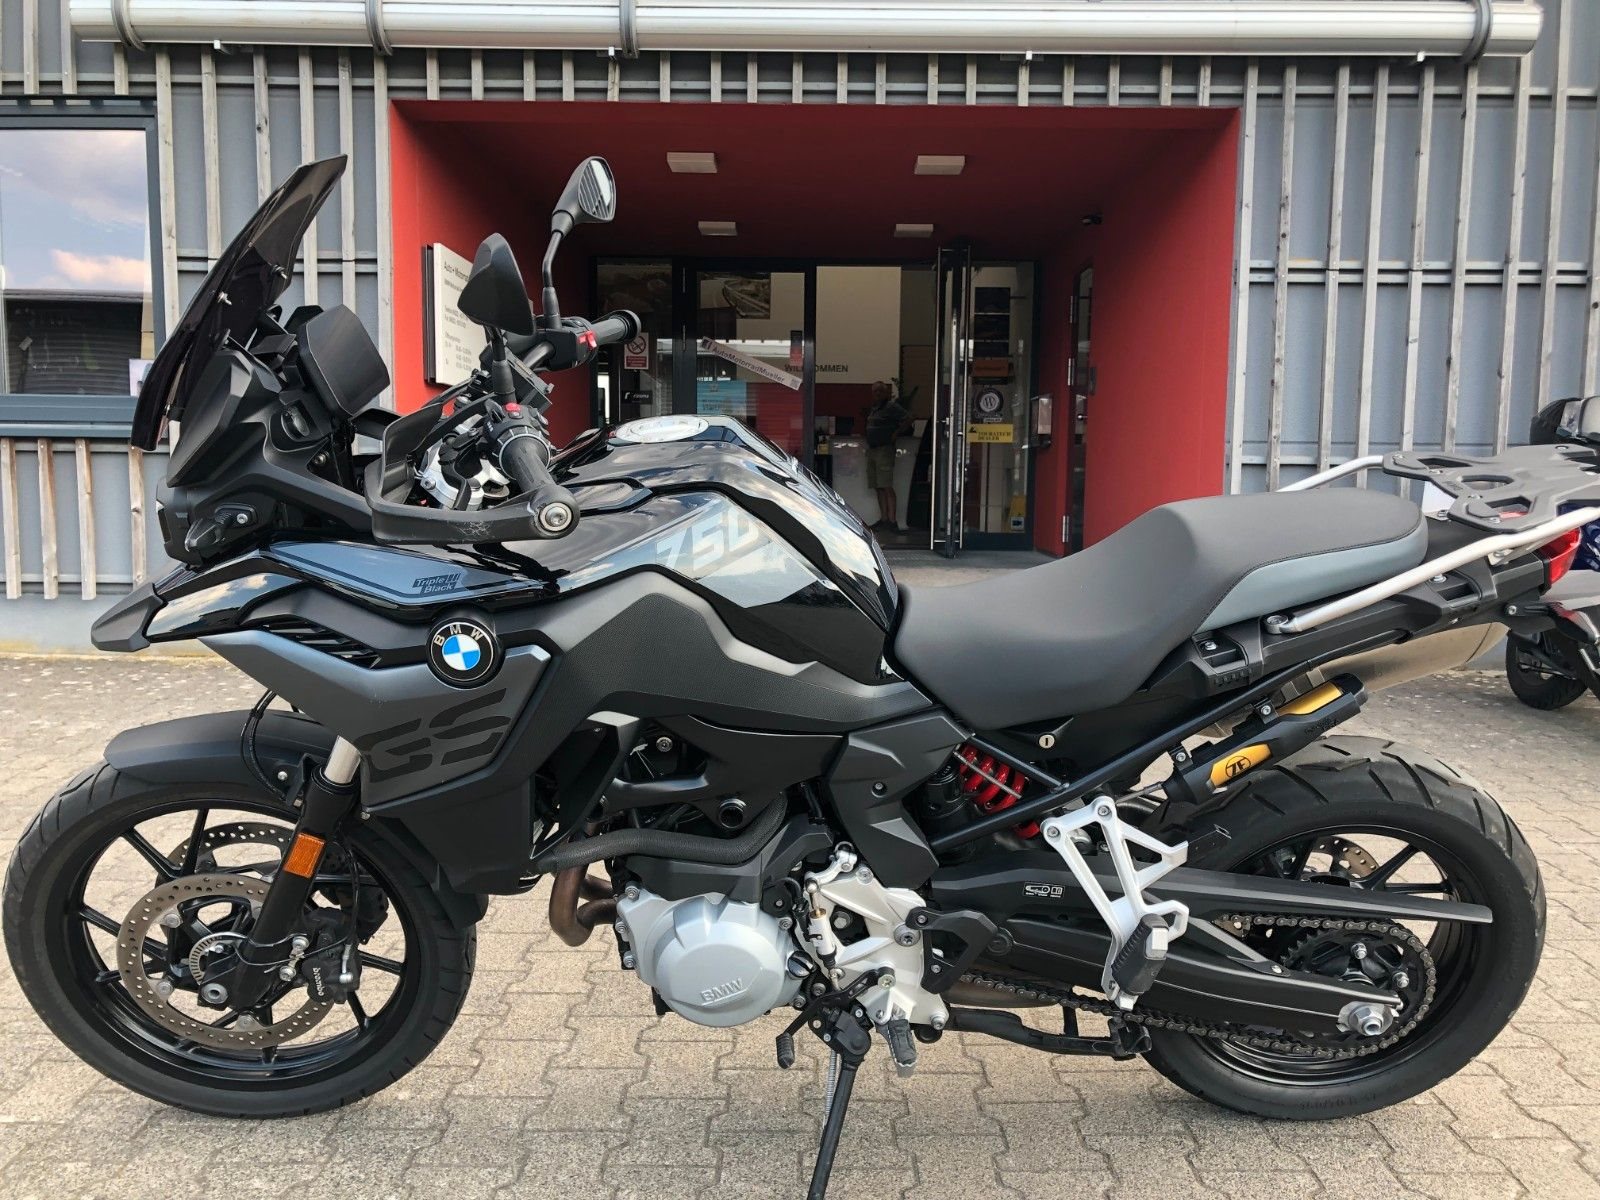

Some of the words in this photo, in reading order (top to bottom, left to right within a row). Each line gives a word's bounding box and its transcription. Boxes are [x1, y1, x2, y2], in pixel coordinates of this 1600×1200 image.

[416, 576, 445, 586] Triple
[424, 584, 453, 593] Black
[433, 623, 485, 647] BMW
[353, 687, 512, 783] GS
[312, 967, 325, 997] brembo
[701, 978, 743, 1001] BMW
